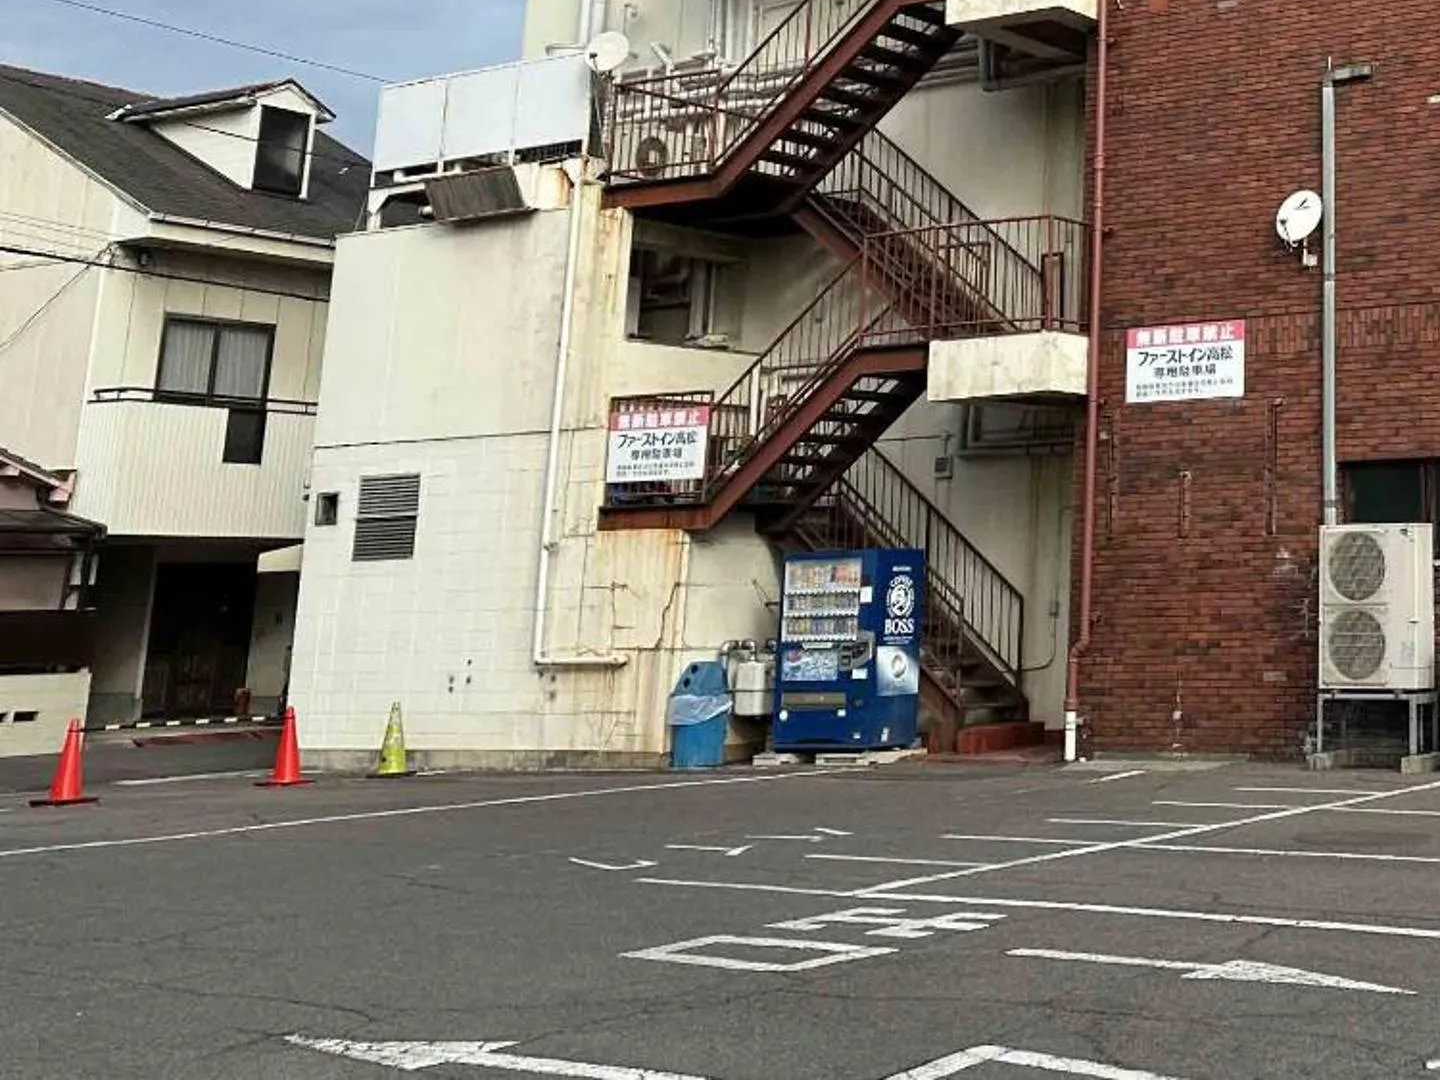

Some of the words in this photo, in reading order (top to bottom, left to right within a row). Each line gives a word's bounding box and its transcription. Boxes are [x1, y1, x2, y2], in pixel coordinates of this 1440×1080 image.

[1137, 344, 1233, 367] ファーストイン高松
[617, 429, 698, 449] ファーストイン高松
[884, 618, 915, 635] BOSS
